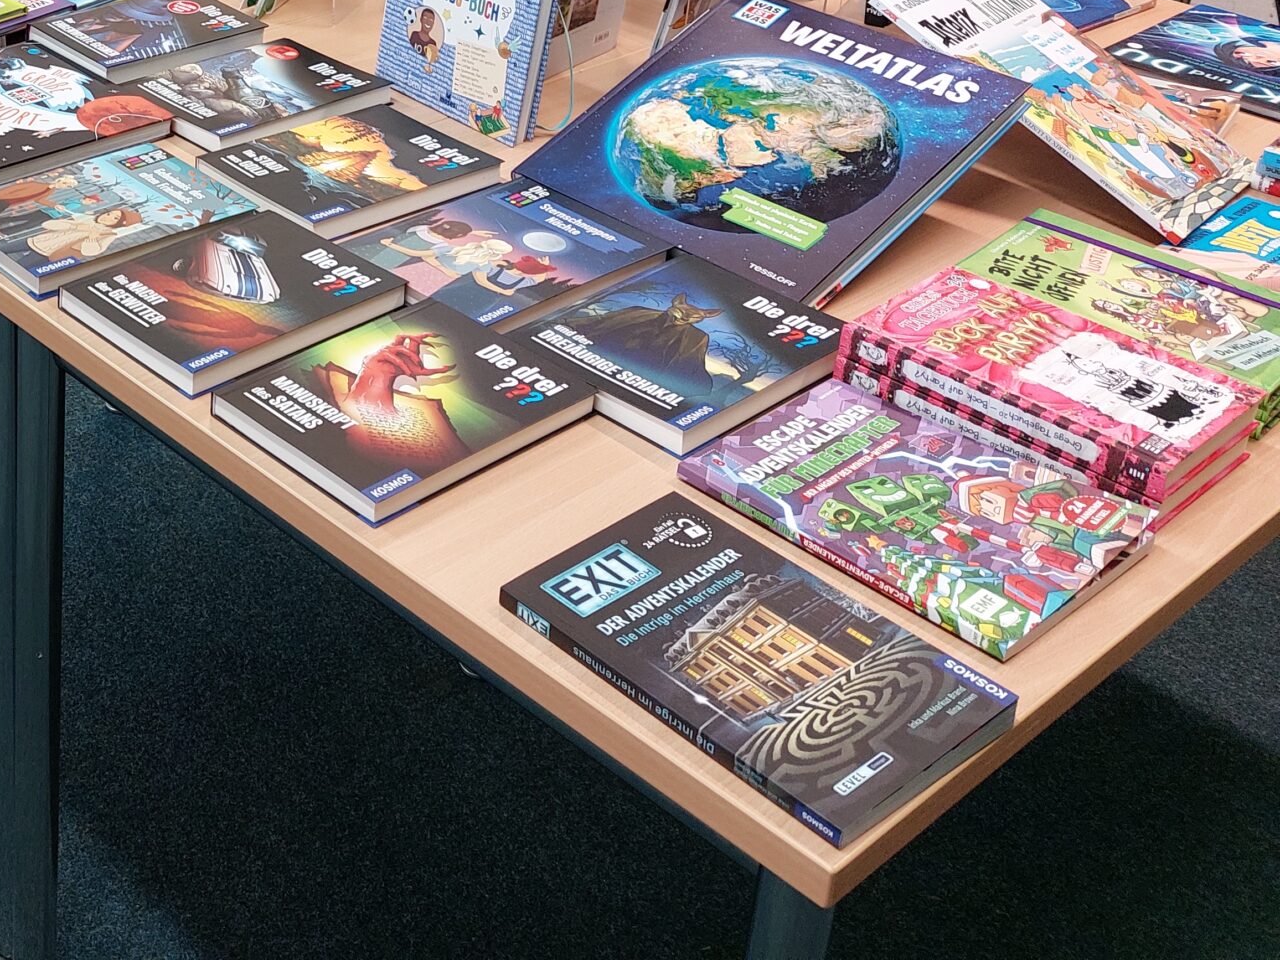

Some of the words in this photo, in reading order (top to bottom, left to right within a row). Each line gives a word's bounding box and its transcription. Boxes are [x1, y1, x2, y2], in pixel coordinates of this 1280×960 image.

[201, 5, 220, 19] Die
[220, 13, 249, 29] drei
[740, 11, 769, 26] WAS
[754, 0, 782, 14] WAS
[778, 20, 980, 103] WELTATLAS
[308, 62, 332, 77] Die
[331, 72, 370, 88] drei
[317, 78, 352, 93] ???
[409, 134, 438, 152] Die
[438, 146, 479, 167] drei
[419, 154, 458, 171] ???
[239, 161, 269, 178] GOLD
[253, 155, 290, 174] STADT
[309, 205, 345, 223] KOSMOS
[538, 203, 618, 243] Sternschnuppen-
[544, 215, 582, 237] Nächte
[36, 257, 76, 274] KOSMOS
[301, 247, 338, 269] Die
[331, 264, 382, 289] drei
[987, 248, 1026, 278] BITTE
[1011, 254, 1058, 291] NICHT
[1091, 247, 1108, 272] LUSTIG
[313, 275, 358, 297] ???
[748, 262, 797, 287] TESSLOFF
[94, 281, 113, 292] der
[108, 288, 167, 324] GEWITTER
[113, 274, 129, 286] Die
[127, 280, 168, 306] NACHT
[475, 303, 514, 326] KOSMOS
[743, 296, 785, 319] Die
[781, 313, 840, 340] drei
[923, 316, 996, 354] BOCK
[975, 291, 1022, 320] AUF
[553, 323, 576, 336] und
[573, 333, 594, 345] der
[767, 324, 820, 349] ???
[975, 311, 1060, 365] PARTY?
[188, 350, 229, 369] KOSMOS
[474, 343, 518, 370] Die
[511, 363, 569, 396] drei
[538, 329, 621, 379] DREIÄUGIGE
[616, 370, 684, 407] SCHAKAL
[493, 376, 545, 406] ???
[913, 369, 948, 392] Party?
[948, 384, 966, 399] auf
[251, 385, 272, 400] des
[268, 394, 324, 430] SATANS
[271, 375, 360, 430] MANUSKRIPT
[967, 392, 988, 411] Bock
[675, 405, 714, 428] KOSMOS
[737, 404, 876, 486] ADVENTSKALENDER
[752, 414, 819, 453] ESCAPE
[1059, 434, 1084, 451] Gregs
[759, 474, 805, 500] FÜR
[790, 414, 902, 485] MINECRAFTER
[370, 473, 414, 498] KOSMOS
[1067, 500, 1086, 513] 24
[643, 539, 656, 550] 24
[652, 525, 682, 544] RÄTSEL
[550, 549, 640, 607] EXIT
[599, 587, 620, 601] DAS
[626, 568, 654, 586] BUCH
[596, 614, 629, 637] DER
[623, 547, 744, 622] ADVENTSKALENDER
[970, 594, 997, 615] EMF
[615, 631, 639, 648] Die
[637, 611, 674, 637] Intrige
[684, 568, 746, 608] Herrenhaus
[517, 606, 549, 637] EXIT
[572, 645, 636, 698] Herrenhaus
[943, 658, 1009, 700] KOSMOS
[654, 703, 695, 736] Intrige
[696, 735, 716, 756] Die
[836, 771, 868, 794] LEVEL
[801, 810, 835, 839] KOSMOS
